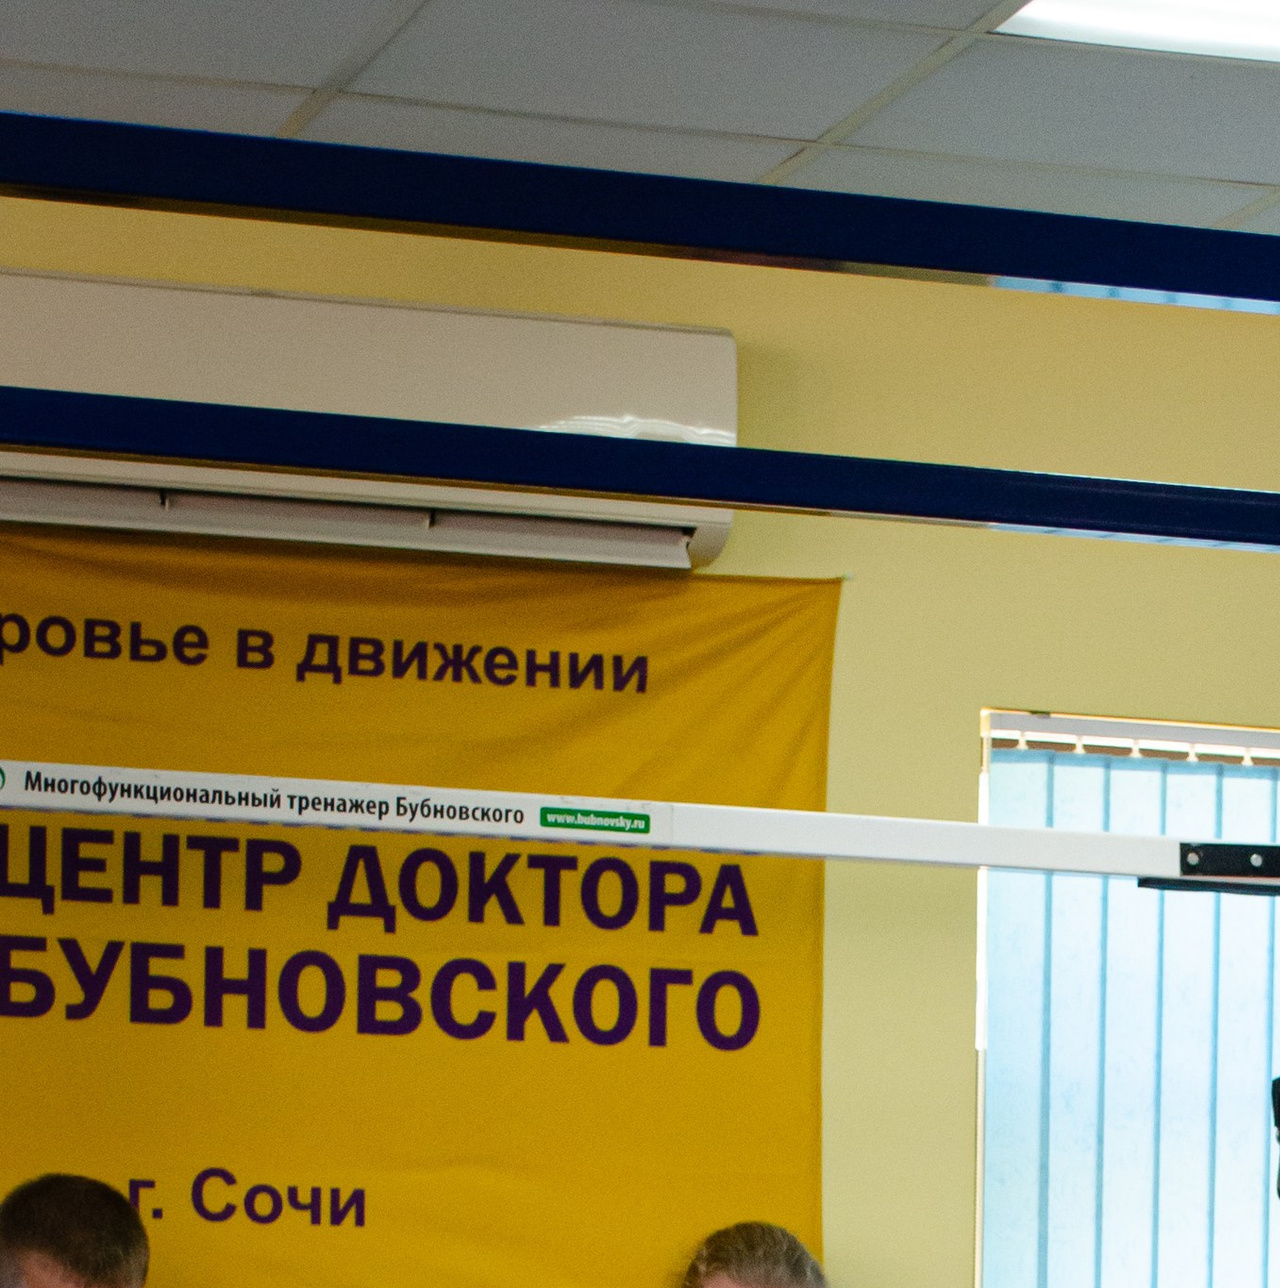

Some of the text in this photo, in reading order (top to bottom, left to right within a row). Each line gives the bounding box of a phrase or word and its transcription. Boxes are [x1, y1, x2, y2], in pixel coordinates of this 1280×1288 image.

[236, 628, 275, 669] в
[295, 633, 650, 694] движении
[24, 770, 525, 825] Многофункциональный тренажер Бубновского
[546, 811, 646, 831] www.bubnovsky.ru
[0, 823, 760, 938] ЦЕНТР ДОКТОРА
[0, 934, 762, 1053] БУБНОВСКОГО
[128, 1166, 366, 1228] г. Сочи
